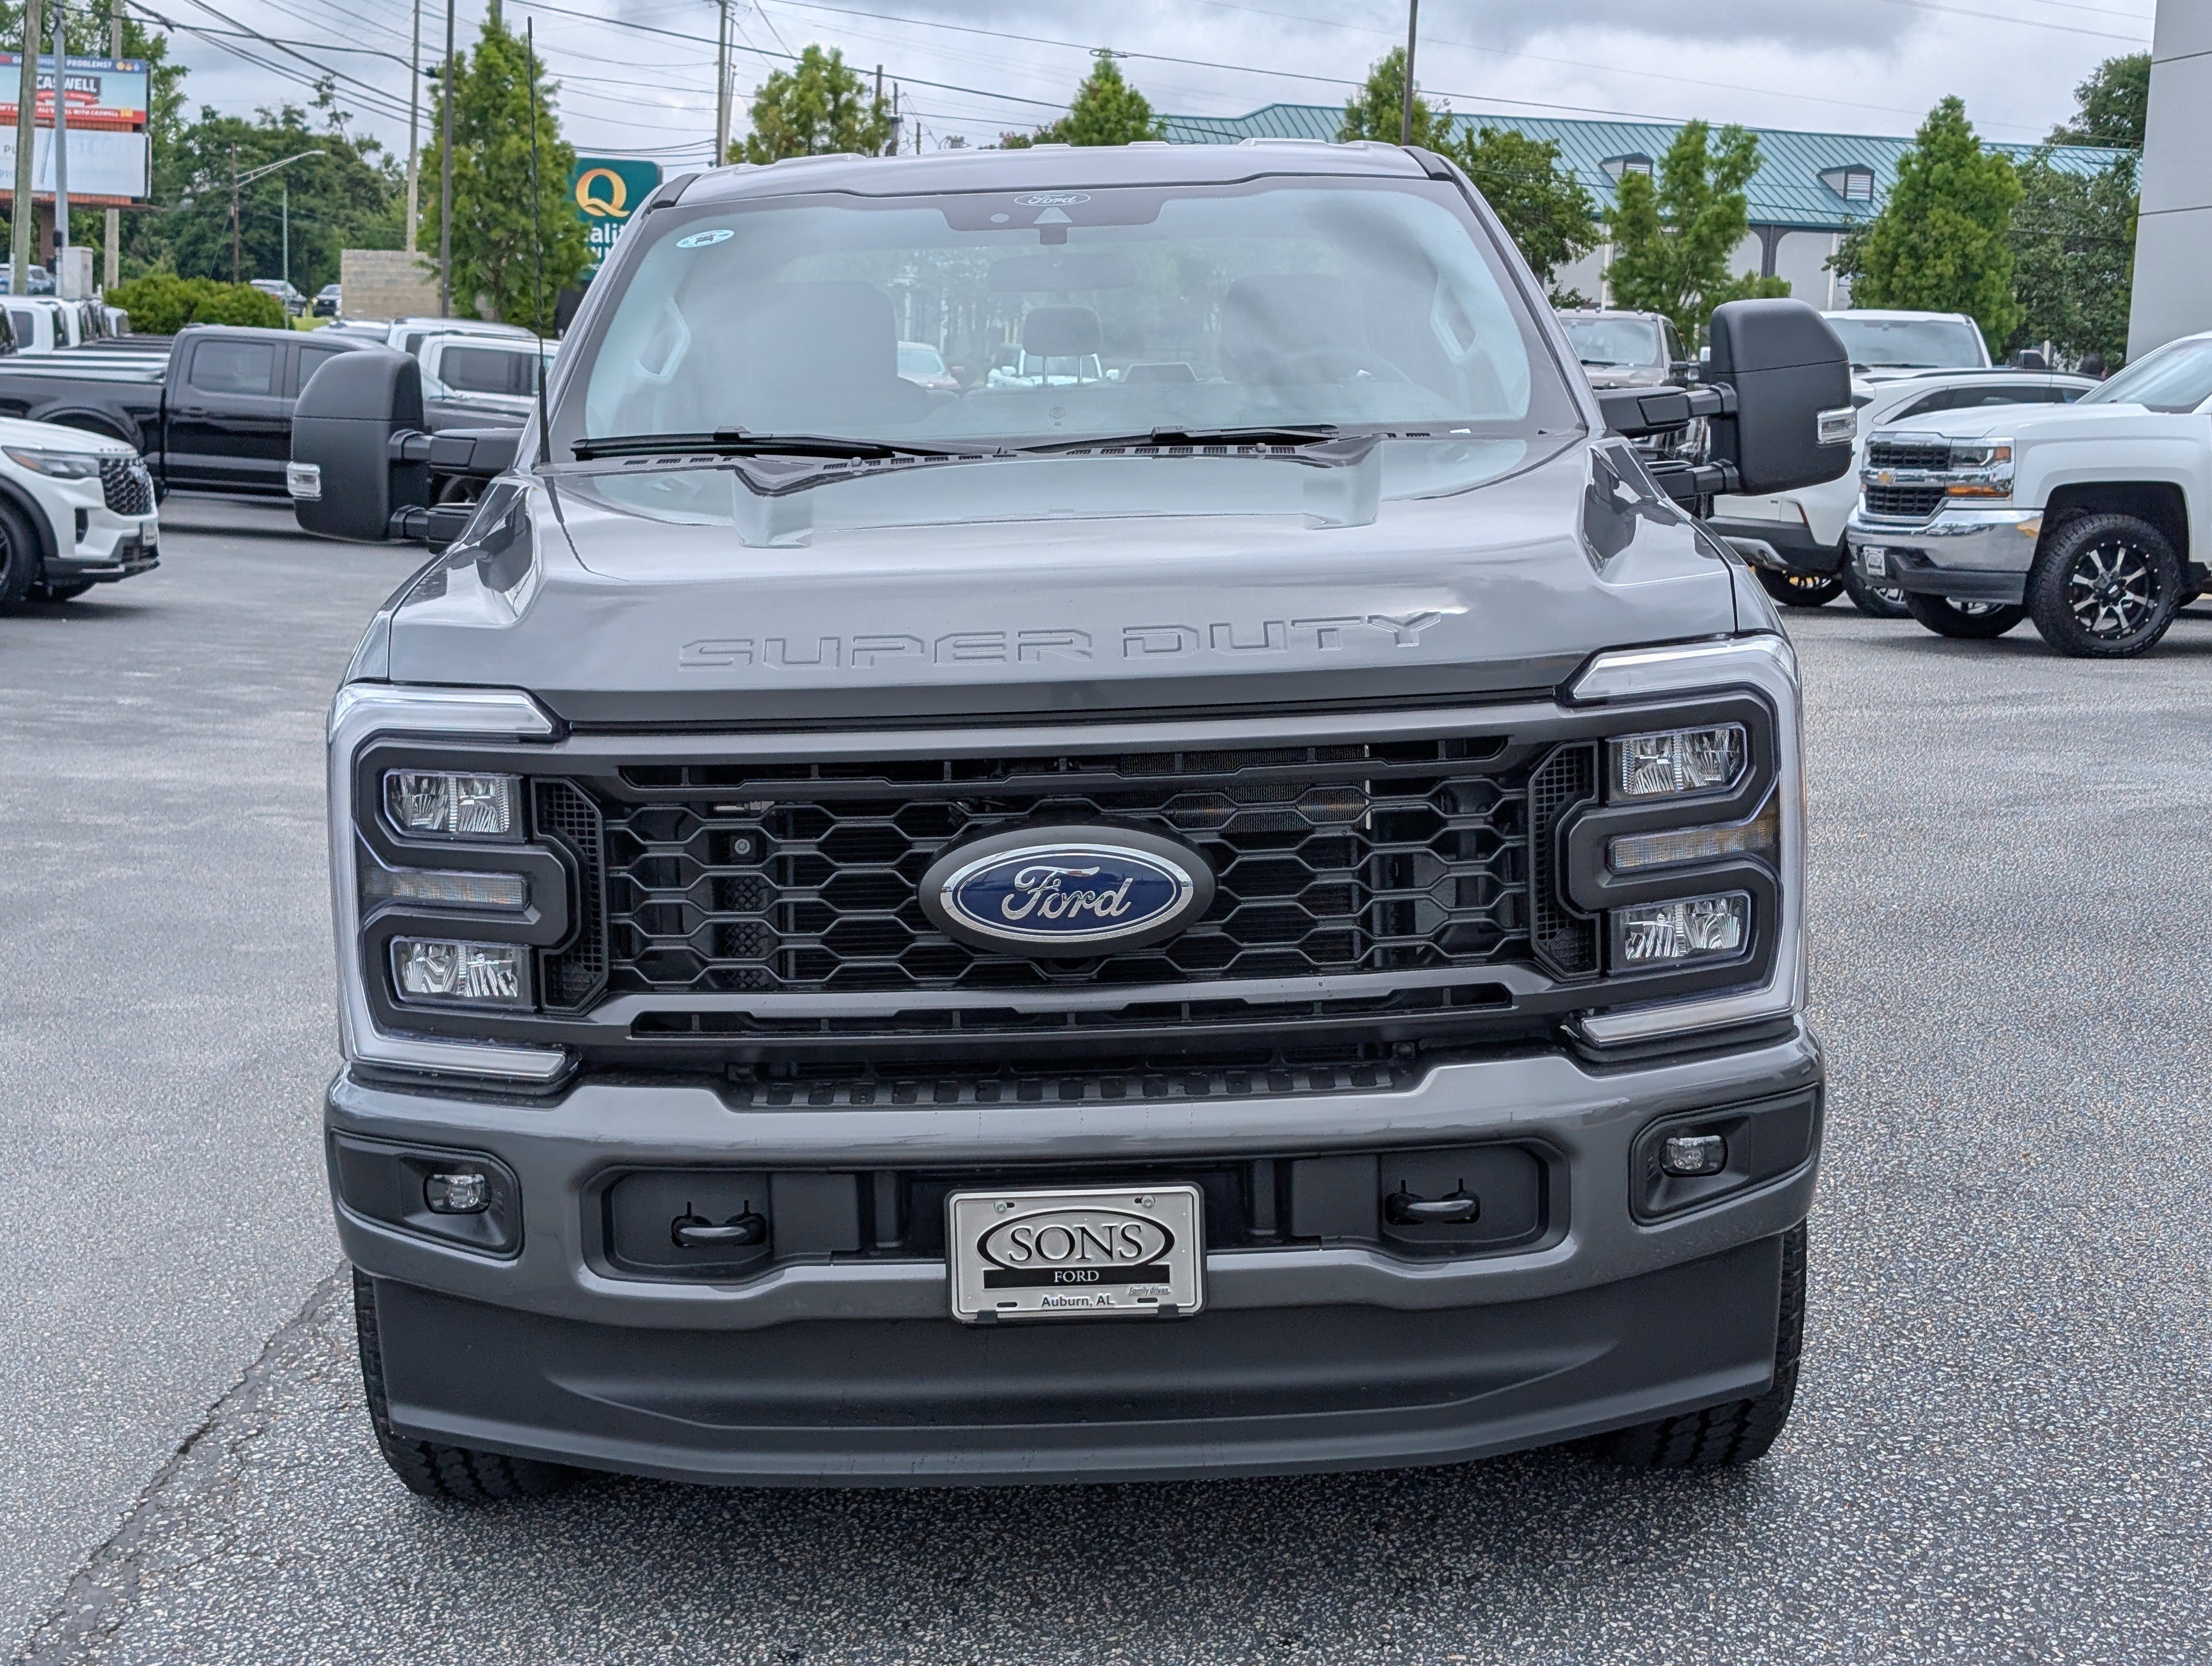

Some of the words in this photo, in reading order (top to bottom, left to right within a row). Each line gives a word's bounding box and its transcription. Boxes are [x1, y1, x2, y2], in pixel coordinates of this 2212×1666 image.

[36, 75, 97, 93] CAWELL
[576, 168, 630, 217] Q
[1028, 194, 1077, 204] Ford
[584, 222, 625, 244] ali
[679, 628, 1094, 671] SUPER
[1122, 612, 1441, 659] DUTY
[1001, 866, 1134, 920] Ford
[1008, 1223, 1143, 1263] SONS
[1053, 1270, 1100, 1283] FORD
[1129, 1286, 1149, 1296] Family
[1041, 1296, 1092, 1308] Auburn,
[1096, 1295, 1114, 1306] AL
